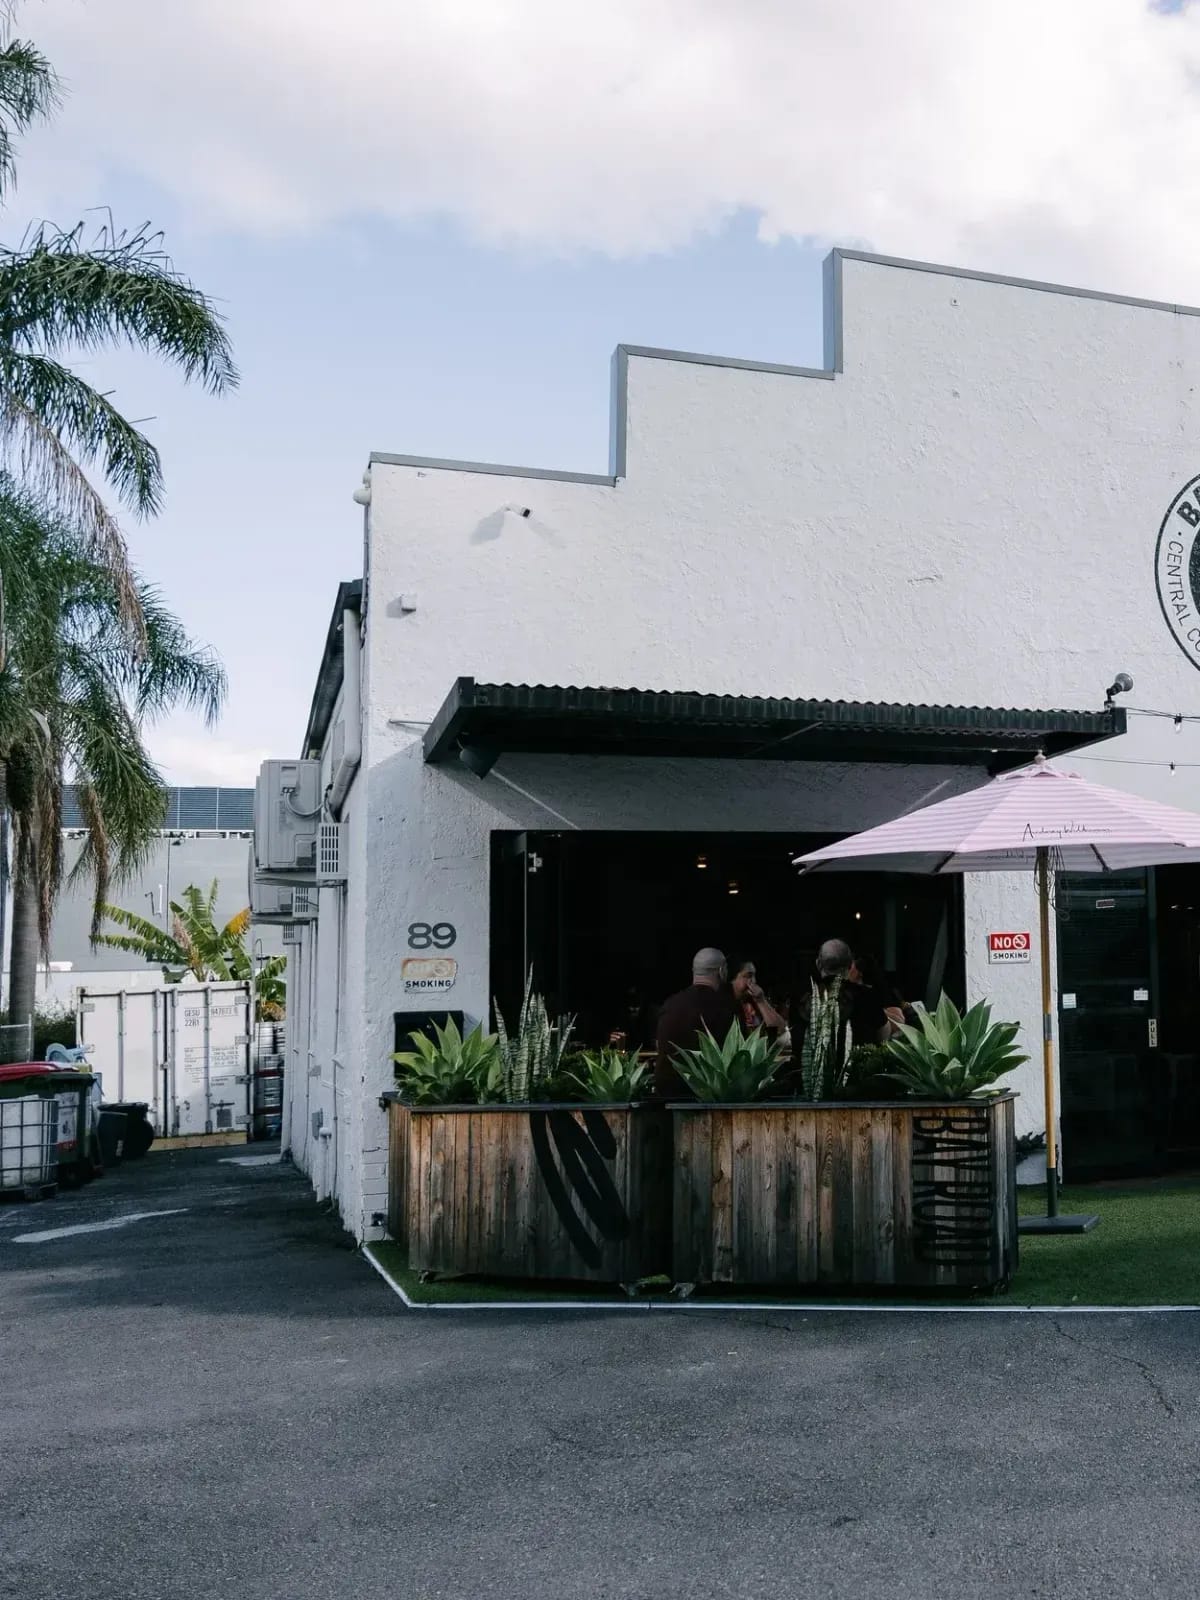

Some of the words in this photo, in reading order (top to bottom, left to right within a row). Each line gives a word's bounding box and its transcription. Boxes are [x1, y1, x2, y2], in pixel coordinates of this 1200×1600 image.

[1166, 540, 1190, 626] CENTRAL
[407, 922, 457, 950] 89
[993, 936, 1012, 949] NO
[993, 952, 1028, 960] SMOKING
[405, 980, 451, 989] SMOKING
[912, 1116, 992, 1171] BAY
